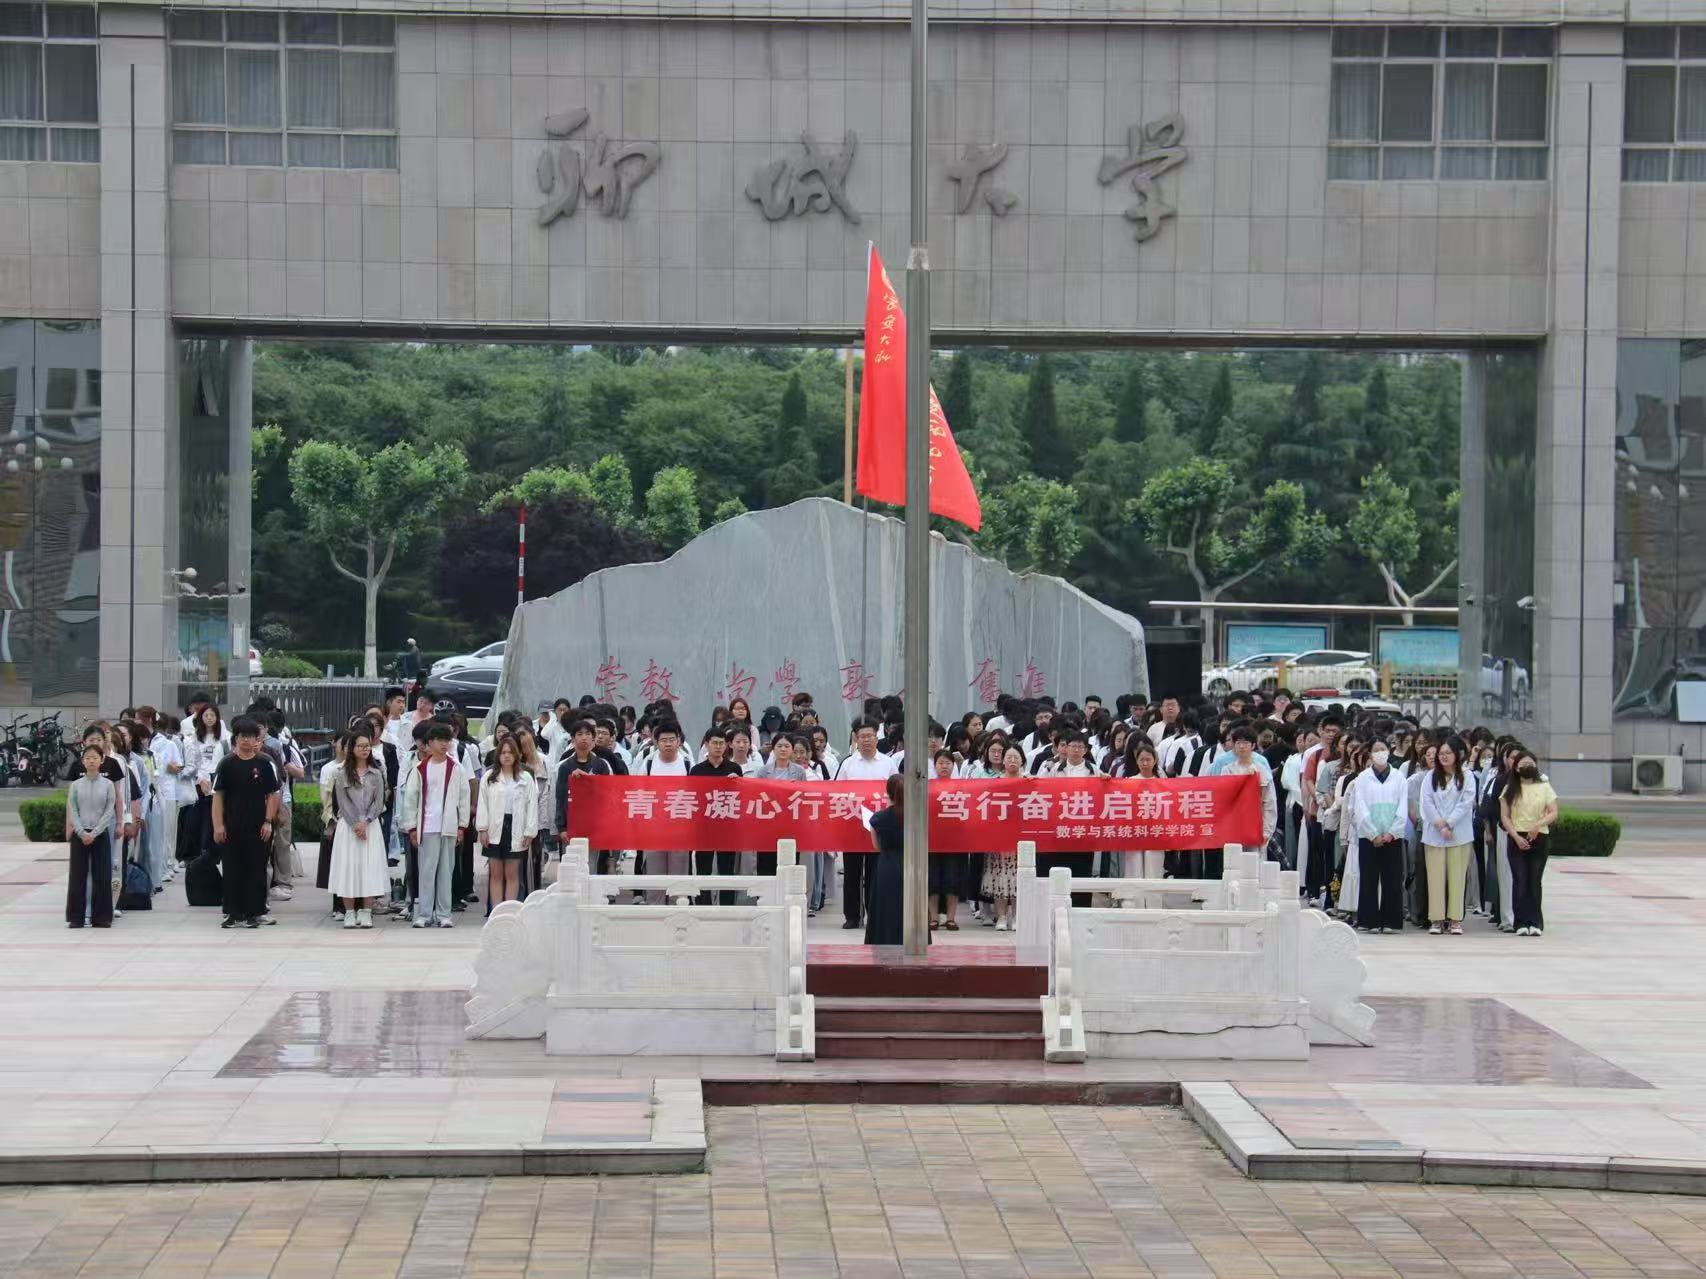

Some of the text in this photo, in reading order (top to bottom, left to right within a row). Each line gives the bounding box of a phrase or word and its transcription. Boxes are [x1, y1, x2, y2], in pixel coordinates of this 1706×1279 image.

[535, 106, 1189, 245] 聊城大学
[936, 790, 1215, 821] 笃行奋进启新程
